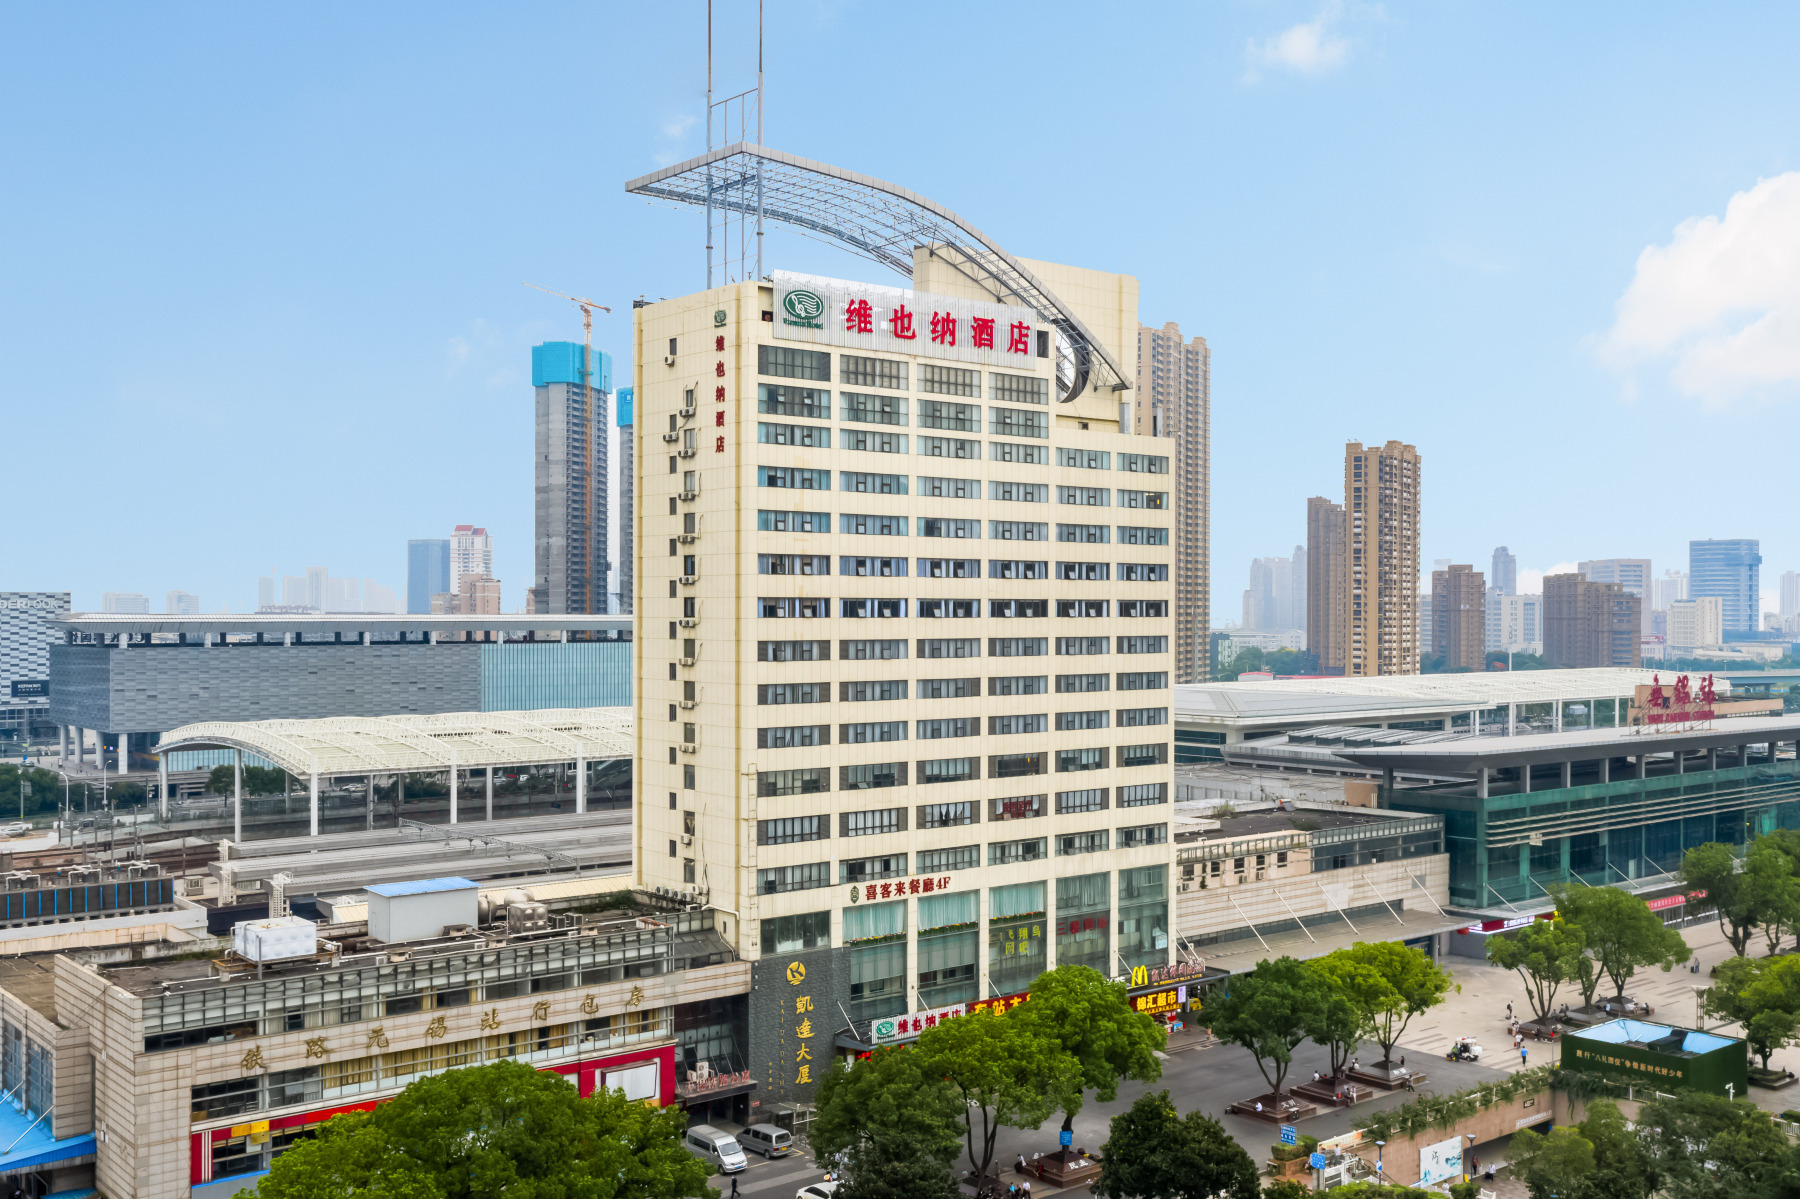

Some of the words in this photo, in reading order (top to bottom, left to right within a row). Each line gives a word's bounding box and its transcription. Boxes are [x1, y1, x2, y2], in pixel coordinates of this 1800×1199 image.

[846, 299, 1030, 355] 维也纳酒店
[715, 335, 725, 453] 维也纳酒店
